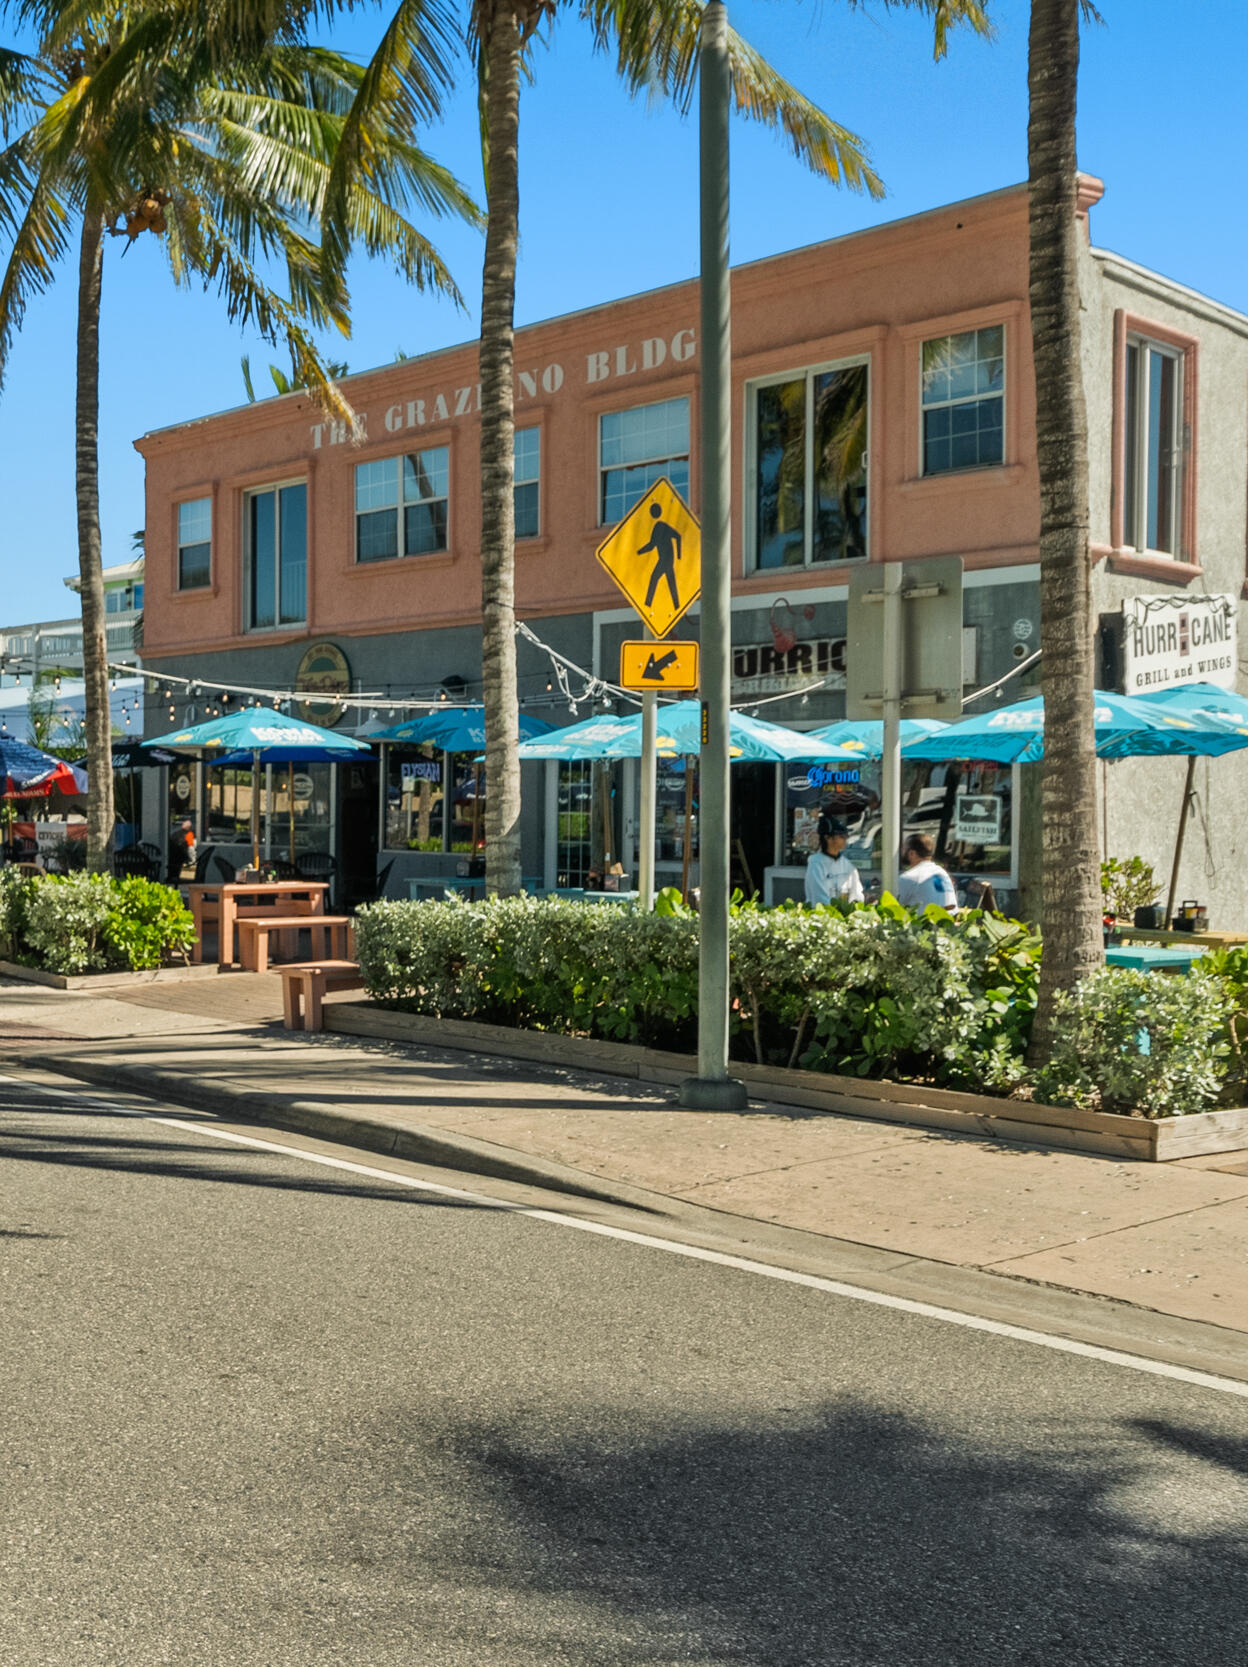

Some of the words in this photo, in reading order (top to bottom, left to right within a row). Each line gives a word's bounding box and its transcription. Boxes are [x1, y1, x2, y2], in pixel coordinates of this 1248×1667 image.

[586, 327, 696, 384] BLDG
[733, 640, 847, 678] URRIC
[1136, 668, 1170, 687] GRILL
[1174, 663, 1193, 679] and
[1197, 655, 1232, 673] WINGS
[807, 766, 861, 788] Corona
